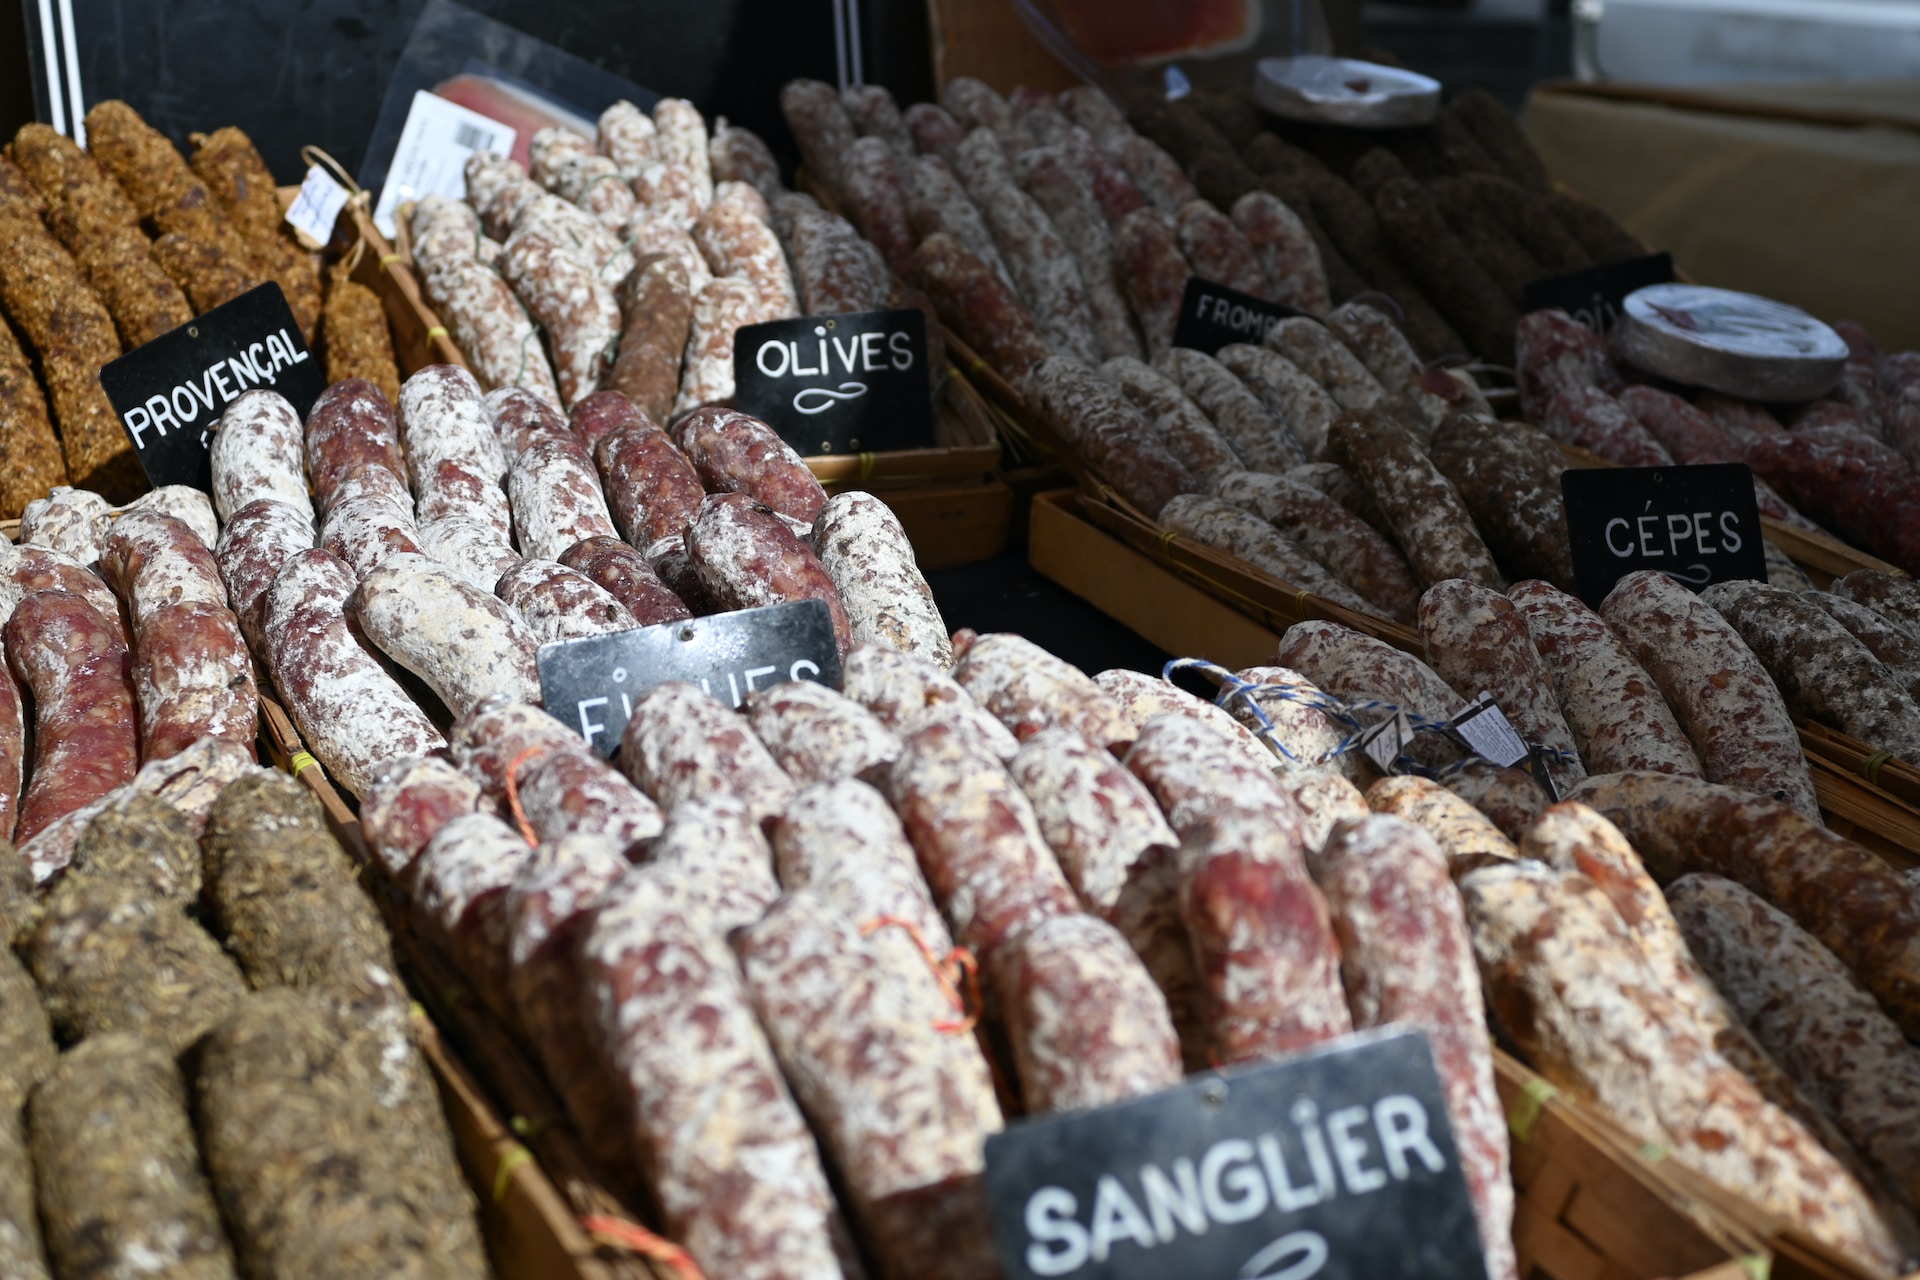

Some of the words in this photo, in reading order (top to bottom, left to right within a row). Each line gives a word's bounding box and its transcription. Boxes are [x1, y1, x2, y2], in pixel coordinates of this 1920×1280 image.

[124, 328, 309, 450] PROVENÇAL
[756, 325, 914, 378] OLiVES
[1605, 500, 1742, 558] CÉPES
[1024, 1094, 1446, 1276] SANGLiER
